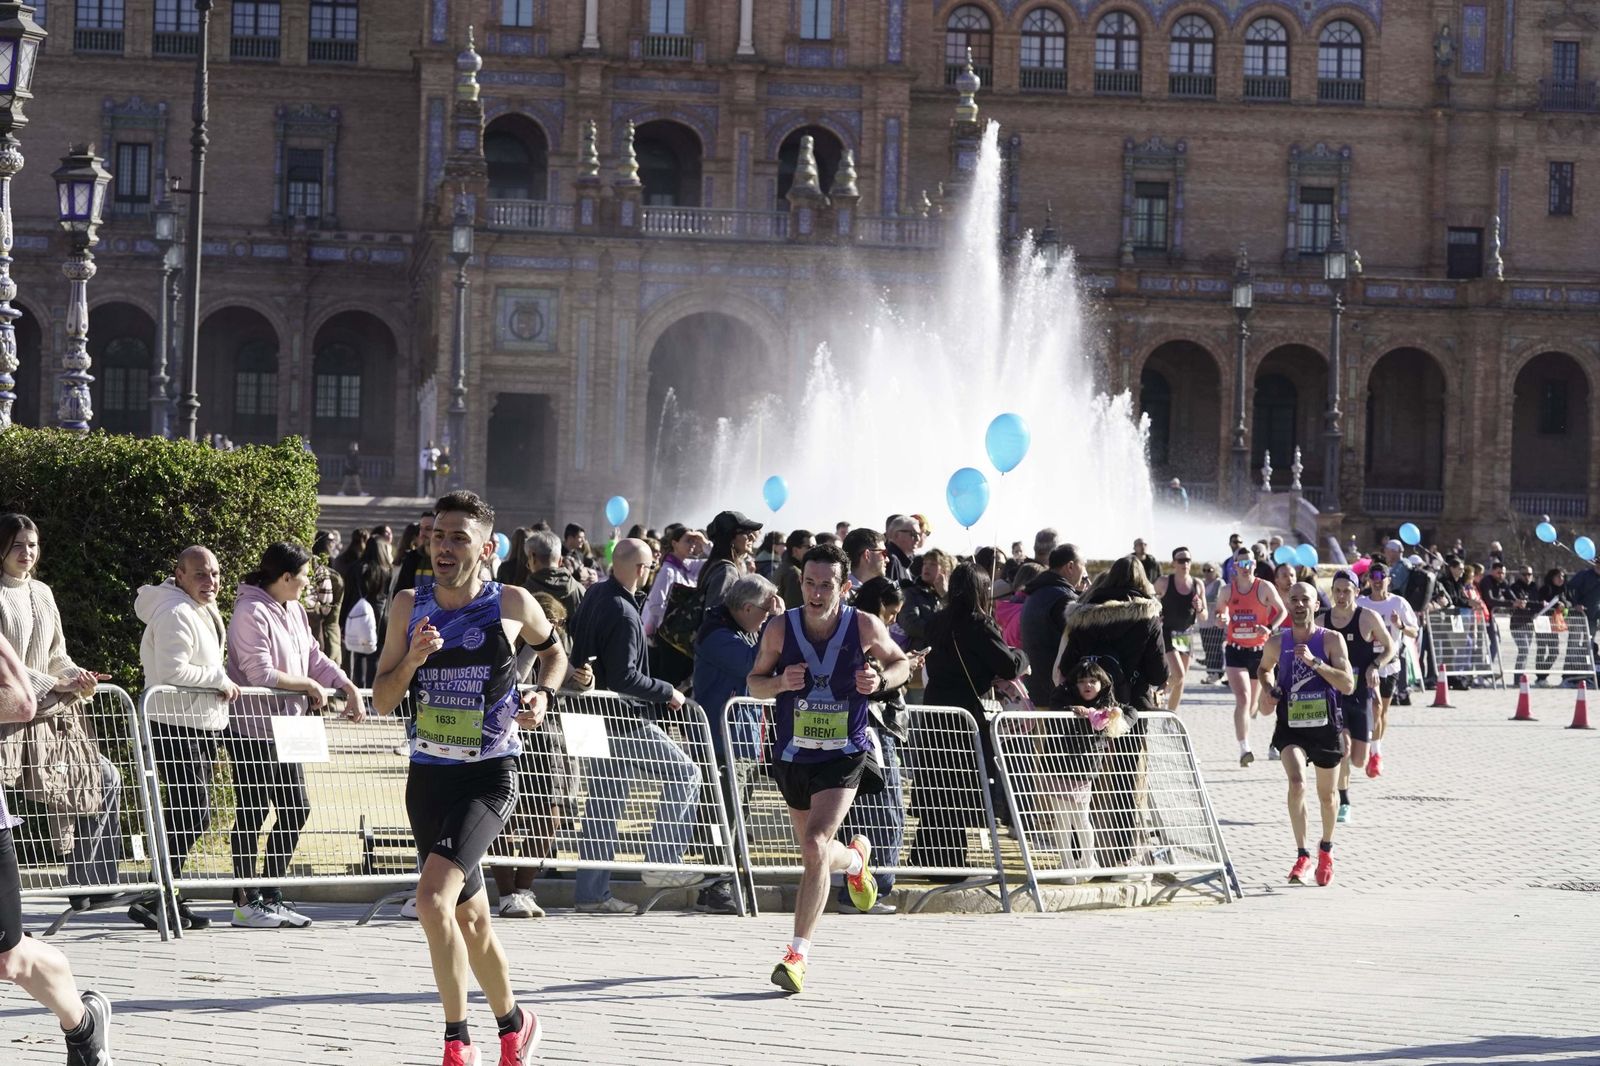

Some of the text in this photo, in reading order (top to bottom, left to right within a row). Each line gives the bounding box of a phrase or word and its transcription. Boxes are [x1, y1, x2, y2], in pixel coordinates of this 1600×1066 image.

[418, 669, 438, 681] CLUB
[434, 695, 475, 706] ZURICH
[812, 703, 843, 711] ZURICH
[435, 715, 457, 725] 1633
[813, 717, 829, 725] 1814
[1292, 712, 1304, 720] GUY
[803, 726, 836, 738] BRENT
[417, 729, 481, 746] RICHARD FABEIRO
